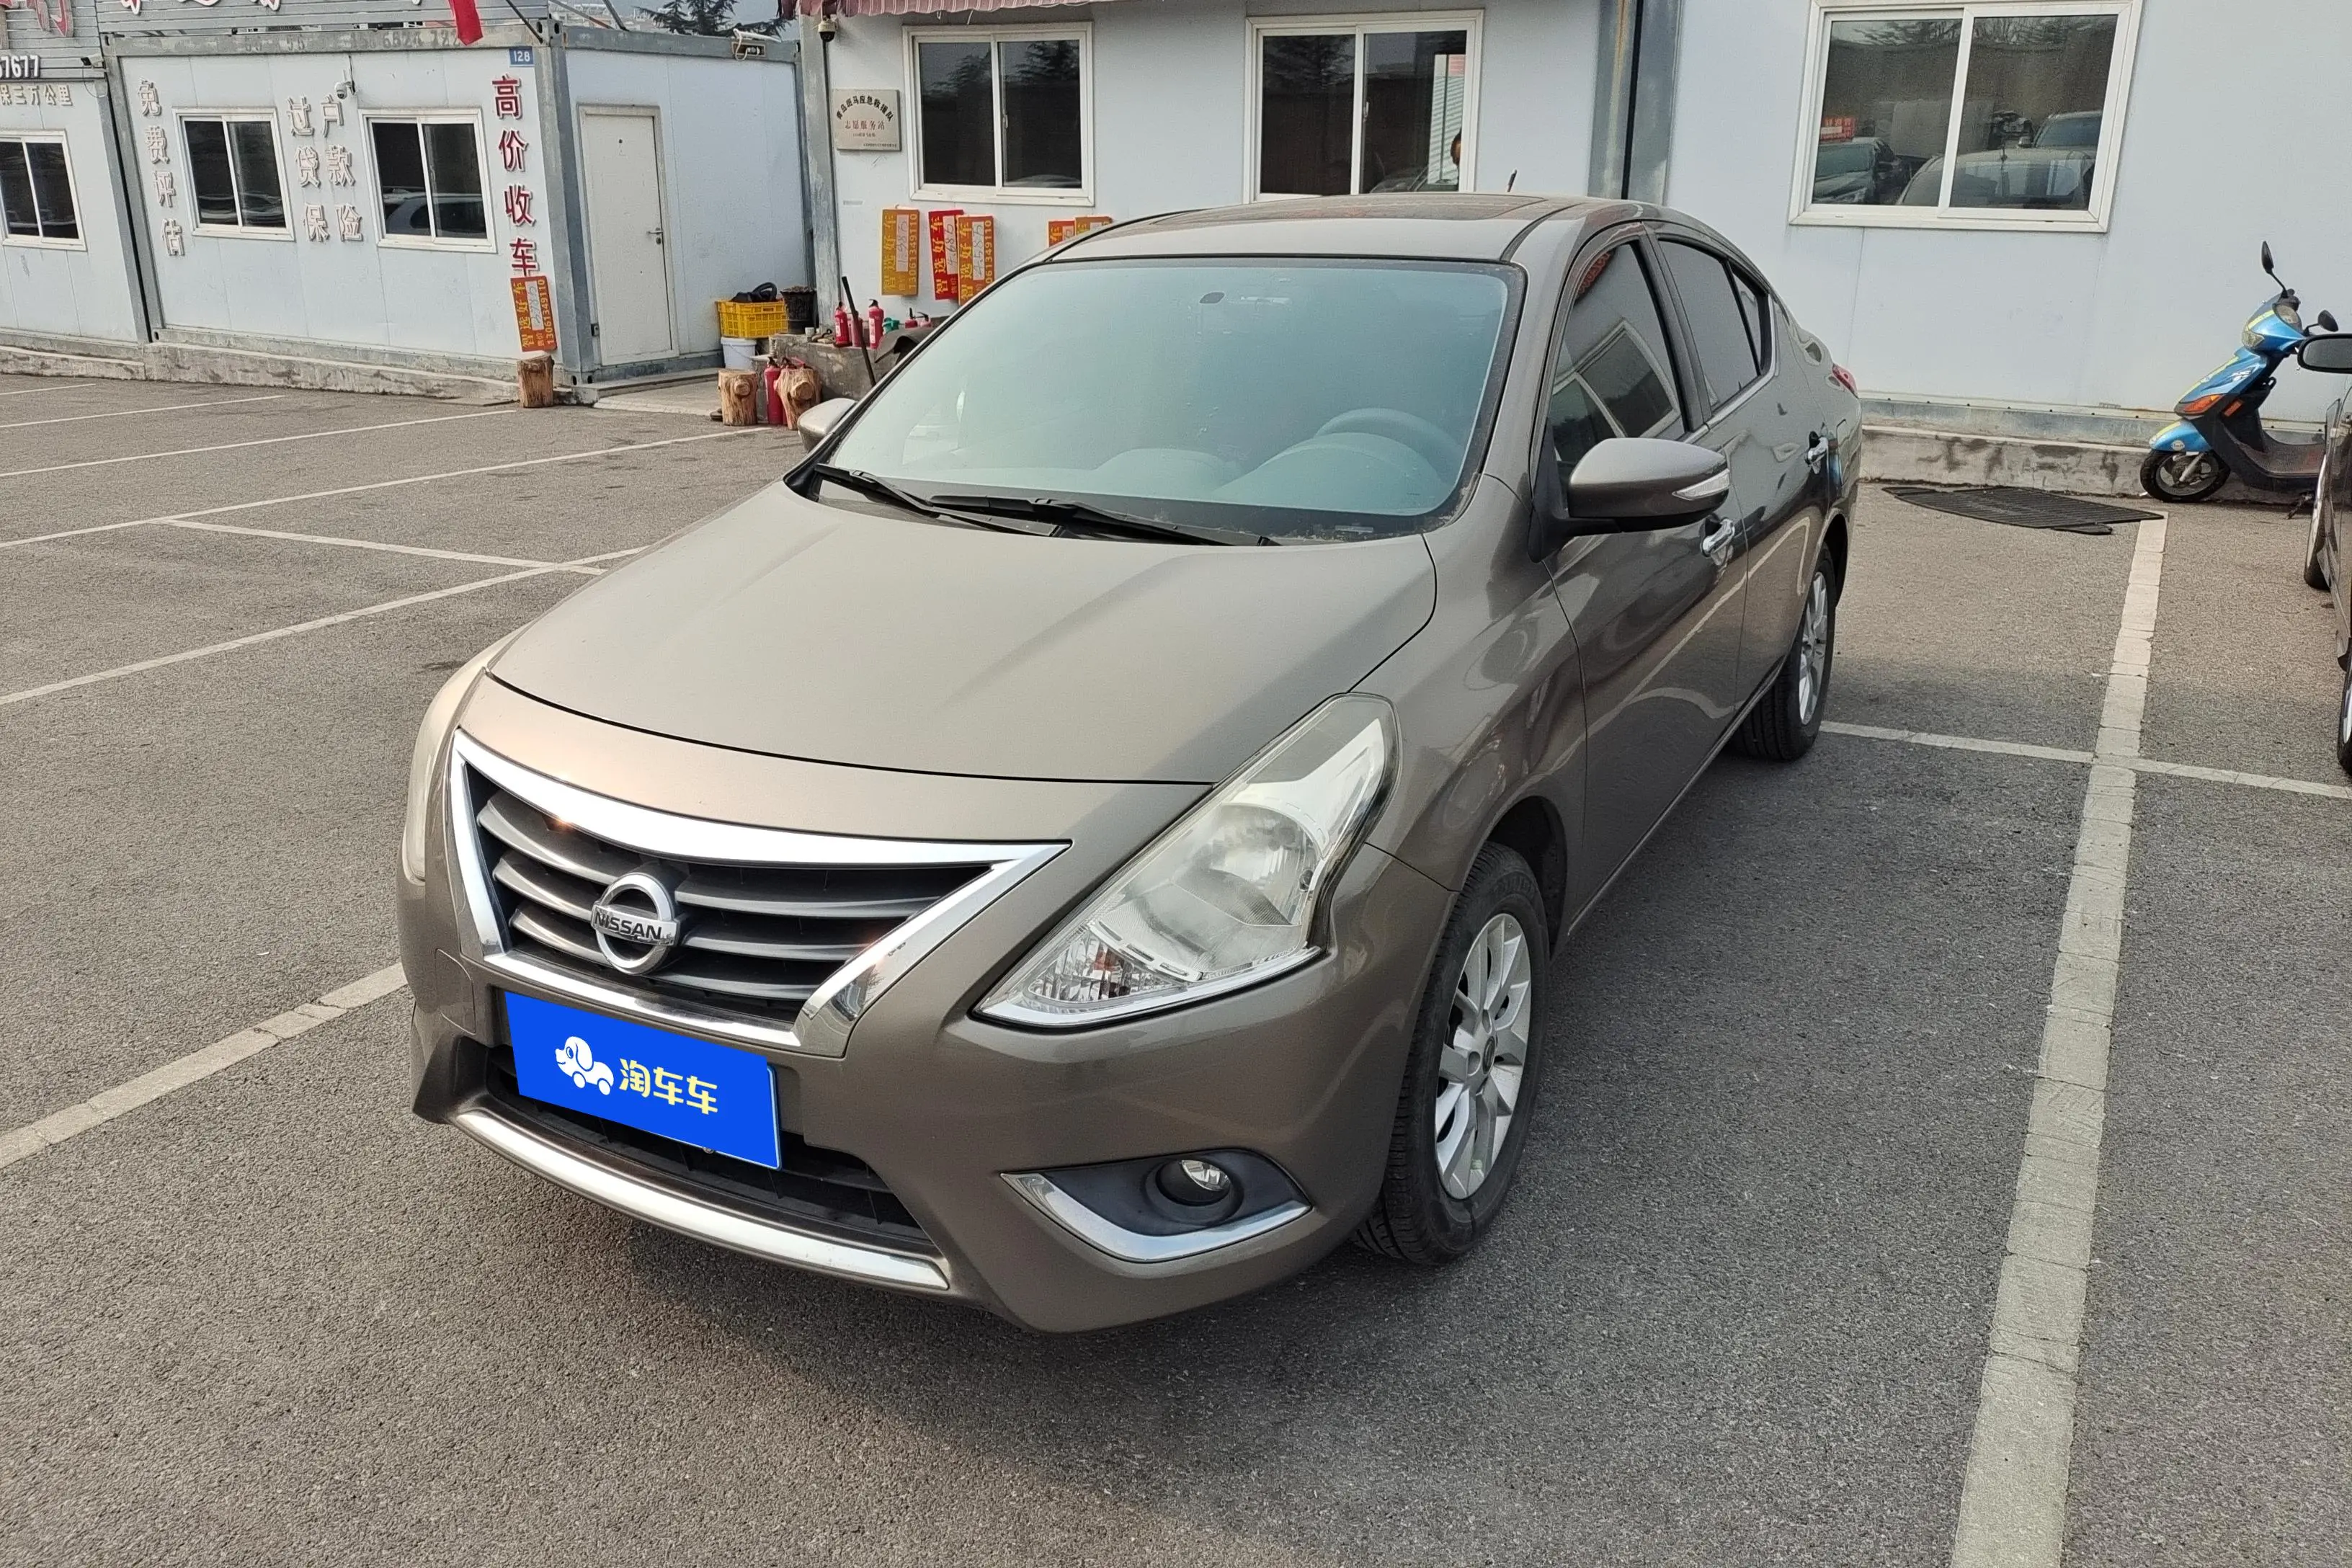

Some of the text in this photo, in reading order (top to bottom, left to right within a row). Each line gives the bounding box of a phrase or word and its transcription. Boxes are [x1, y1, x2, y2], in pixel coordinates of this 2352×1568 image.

[0, 55, 40, 78] 7677
[514, 51, 530, 62] 128
[287, 94, 344, 138] 过户
[138, 77, 184, 256] 免费评估
[295, 144, 355, 189] 贷款
[491, 73, 538, 277] 高价收车
[303, 202, 363, 242] 保险
[883, 215, 896, 291] 智选好车
[930, 216, 948, 295] 智选好车
[960, 222, 974, 300] 智选好车
[513, 282, 535, 347] 智选好车
[538, 279, 555, 344] 13061349110
[594, 907, 662, 941] NISSAN
